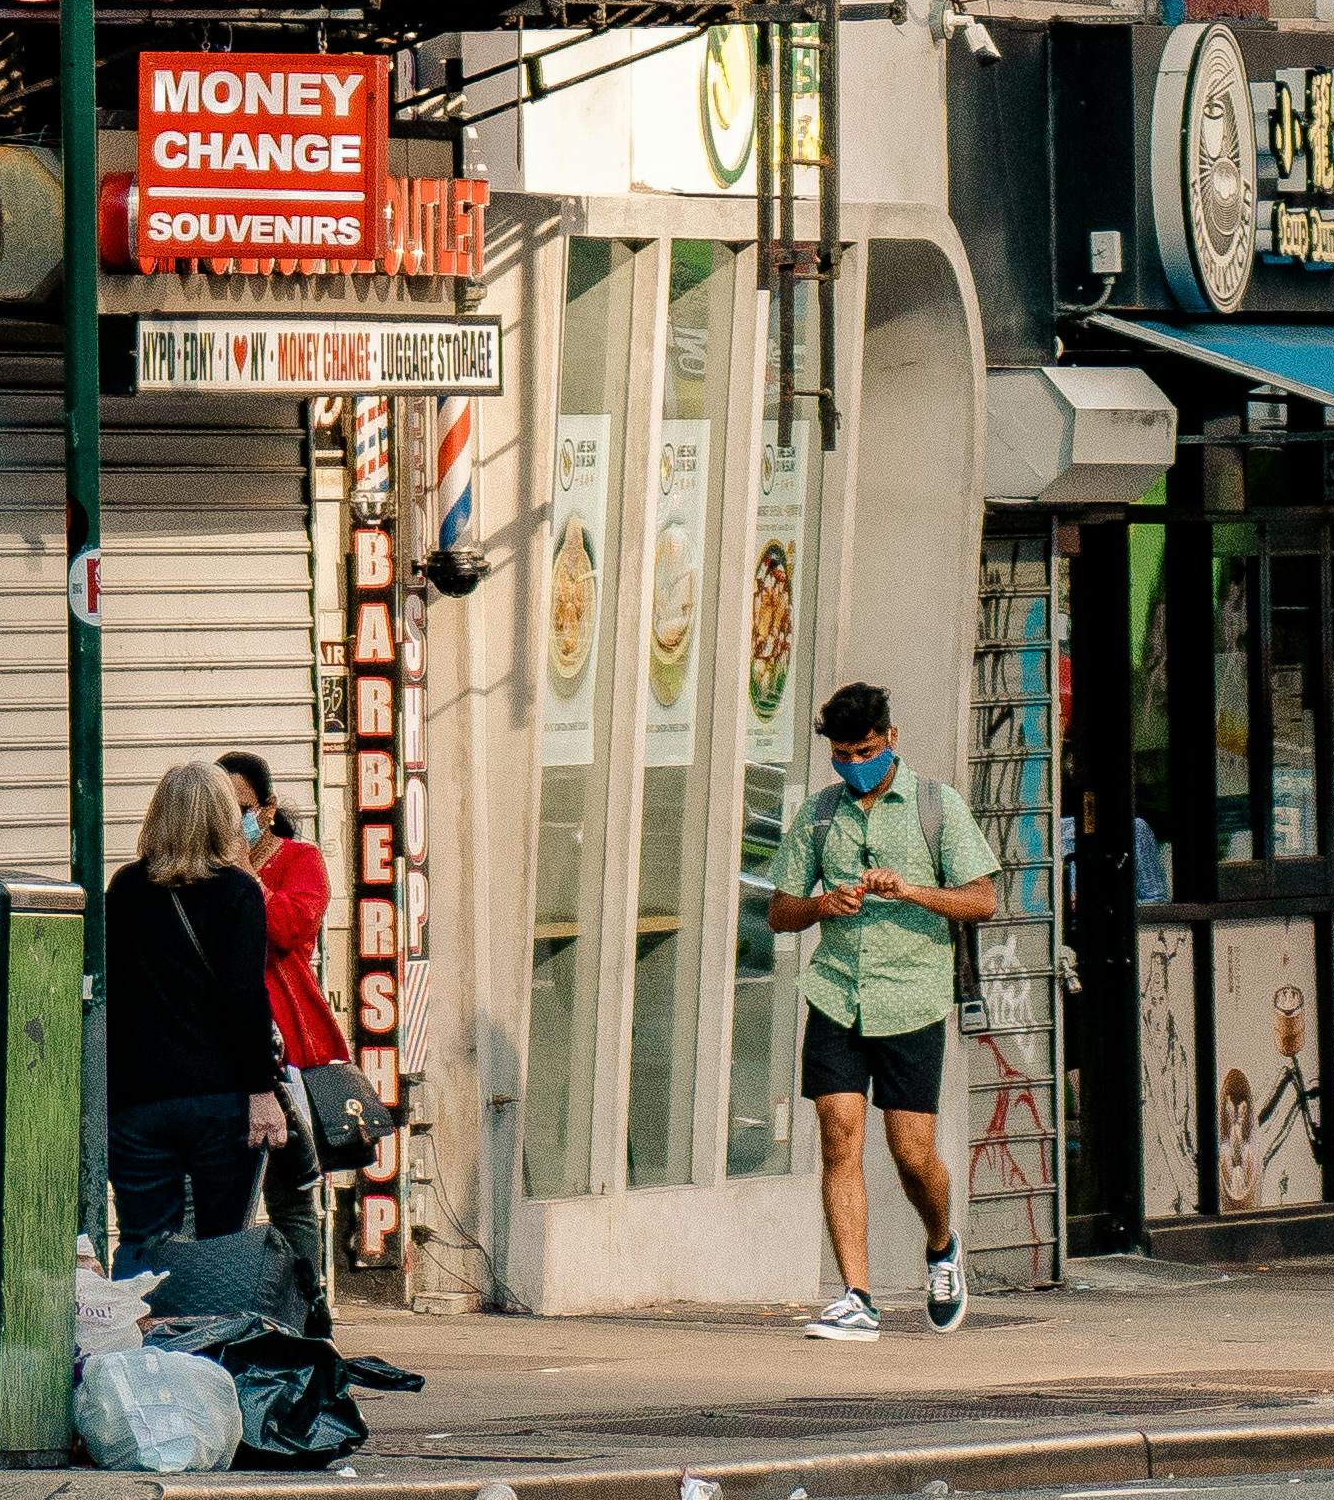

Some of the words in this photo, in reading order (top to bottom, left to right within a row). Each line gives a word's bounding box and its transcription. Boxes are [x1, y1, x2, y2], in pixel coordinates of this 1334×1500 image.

[152, 70, 365, 118] MONEY
[153, 130, 363, 174] CHANGE
[148, 212, 361, 246] SOUVENIRS
[1276, 203, 1310, 260] Soup
[142, 332, 176, 382] NYPD
[183, 332, 215, 382] FDNY
[250, 331, 267, 382] NY
[277, 332, 319, 382] MONEY
[323, 332, 372, 382] CHANGE
[380, 331, 435, 382] LUGGAGE
[436, 329, 493, 380] STORAGE
